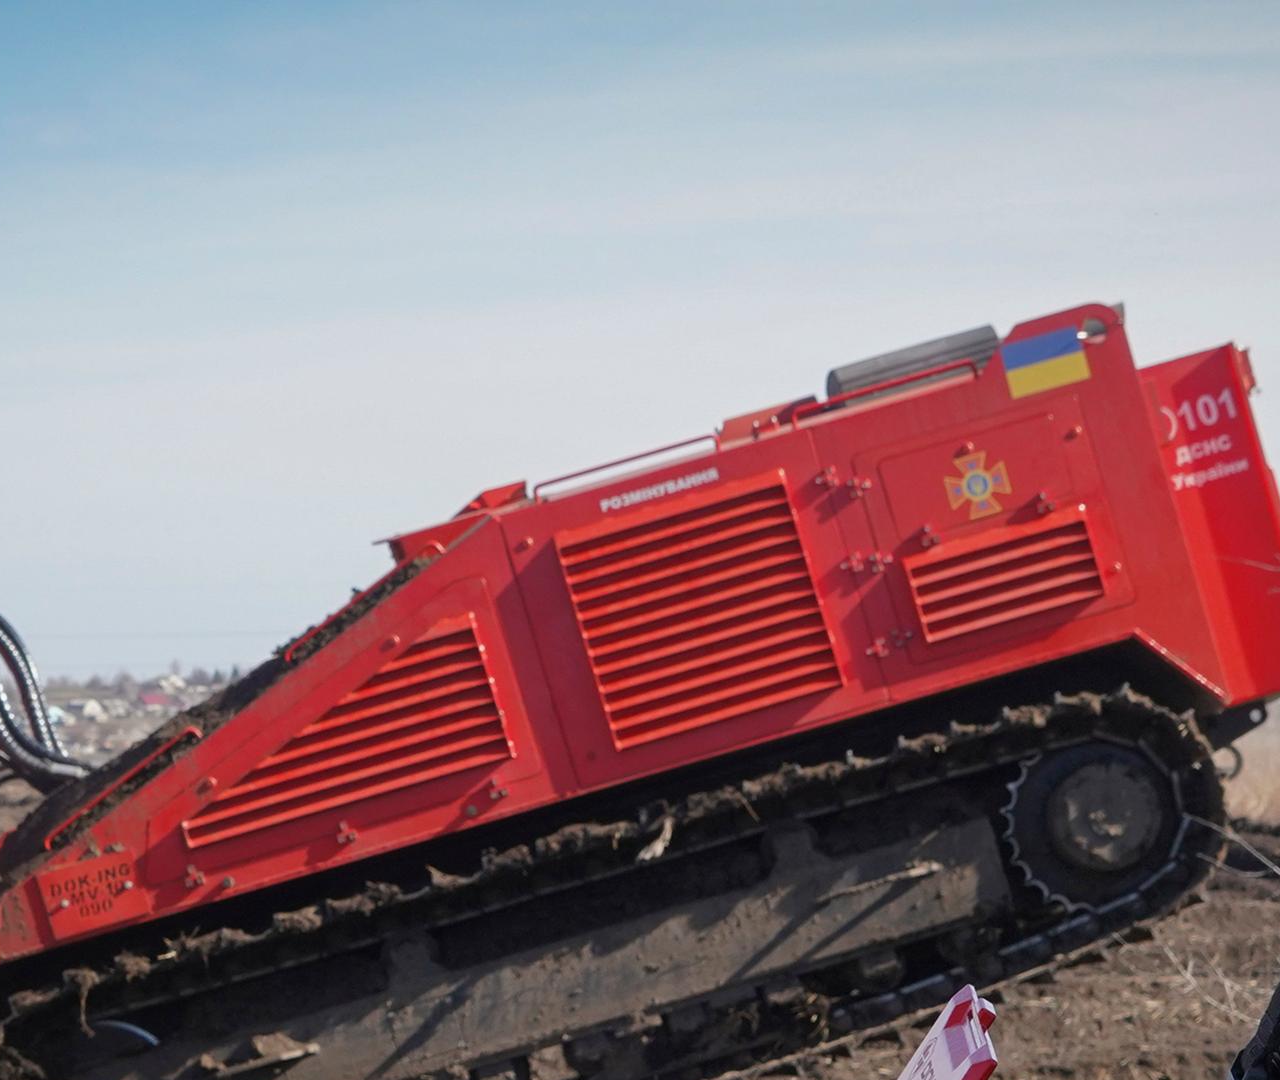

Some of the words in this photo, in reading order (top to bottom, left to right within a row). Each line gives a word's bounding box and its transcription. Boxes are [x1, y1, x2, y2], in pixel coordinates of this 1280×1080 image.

[1178, 388, 1238, 431] 101
[1176, 434, 1232, 466] ДСНС
[600, 467, 719, 512] РОЗМІНУВАННЯ
[1171, 458, 1250, 490] України
